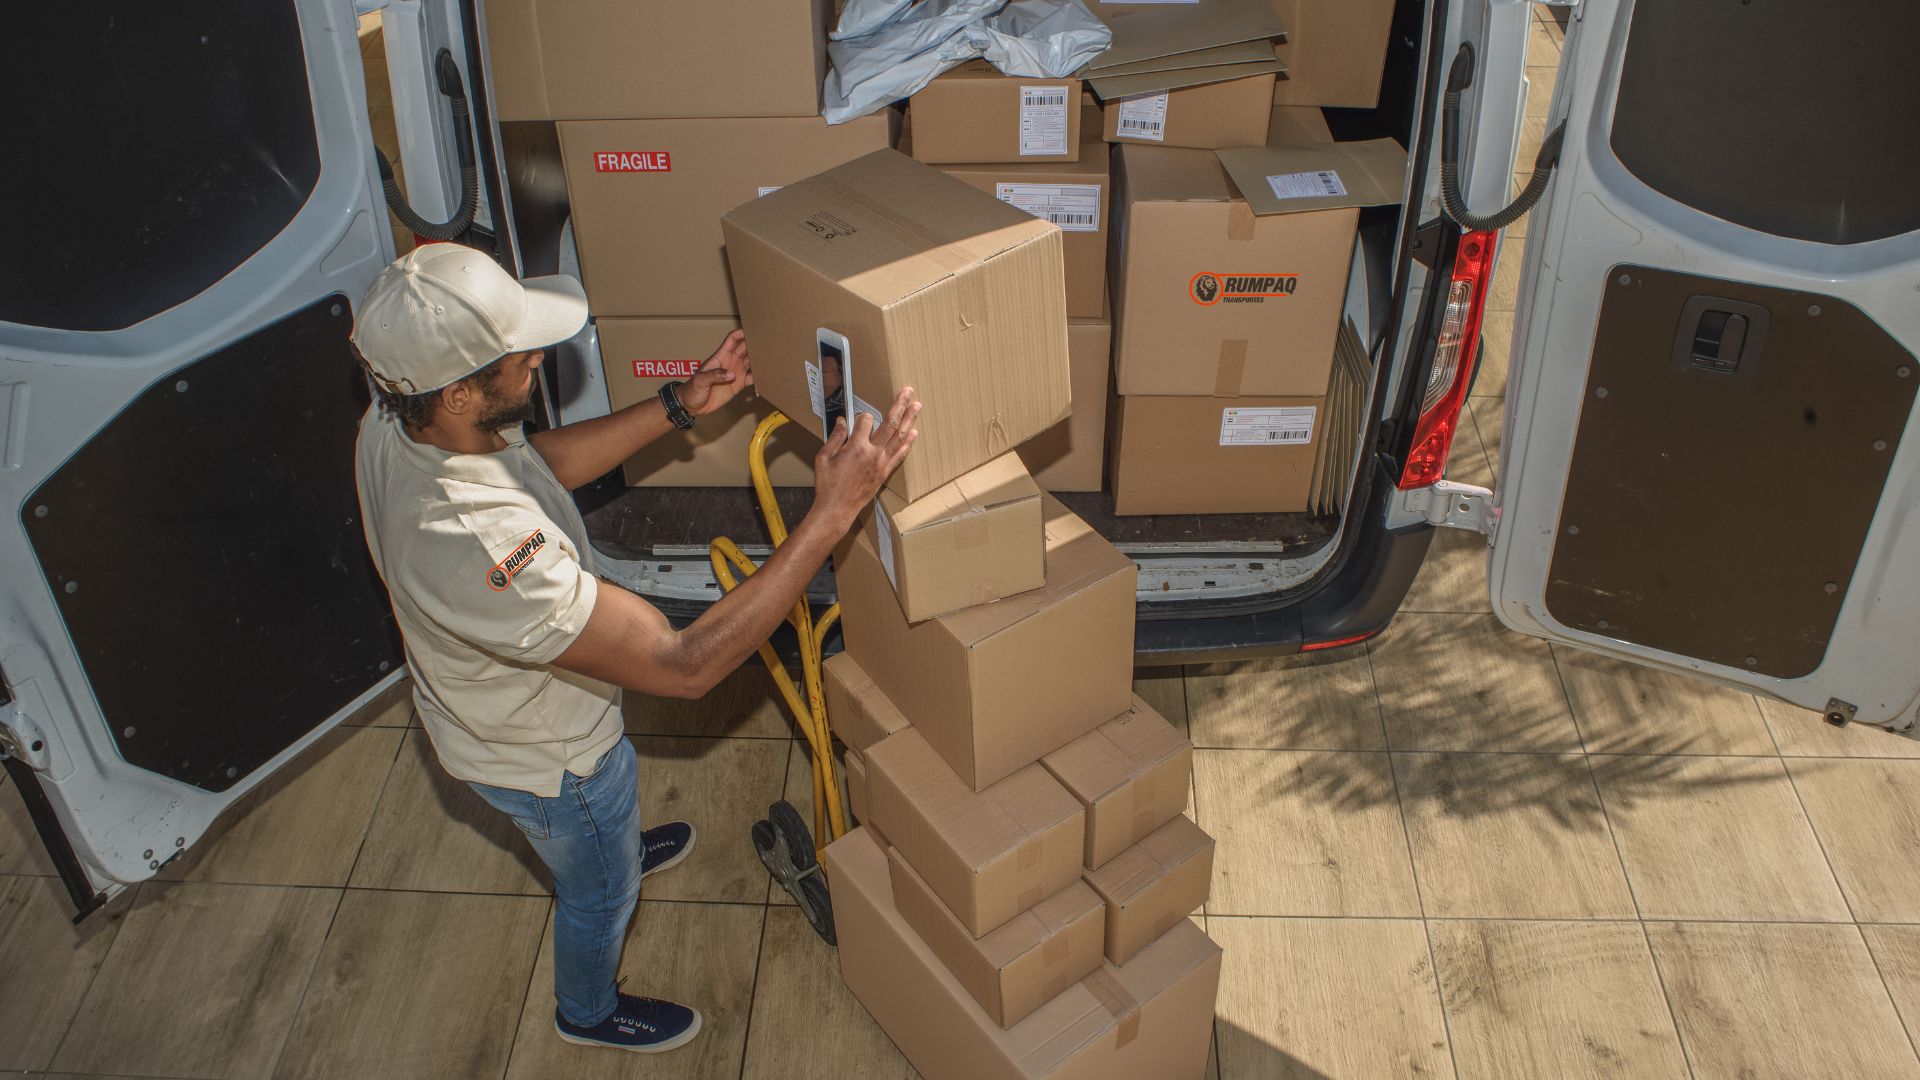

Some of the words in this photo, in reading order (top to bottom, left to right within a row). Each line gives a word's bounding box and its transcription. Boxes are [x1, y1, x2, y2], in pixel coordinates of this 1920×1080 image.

[597, 153, 668, 170] FRAGILE
[1224, 277, 1297, 295] RUMPAQ
[505, 532, 546, 573] RUMPAQ
